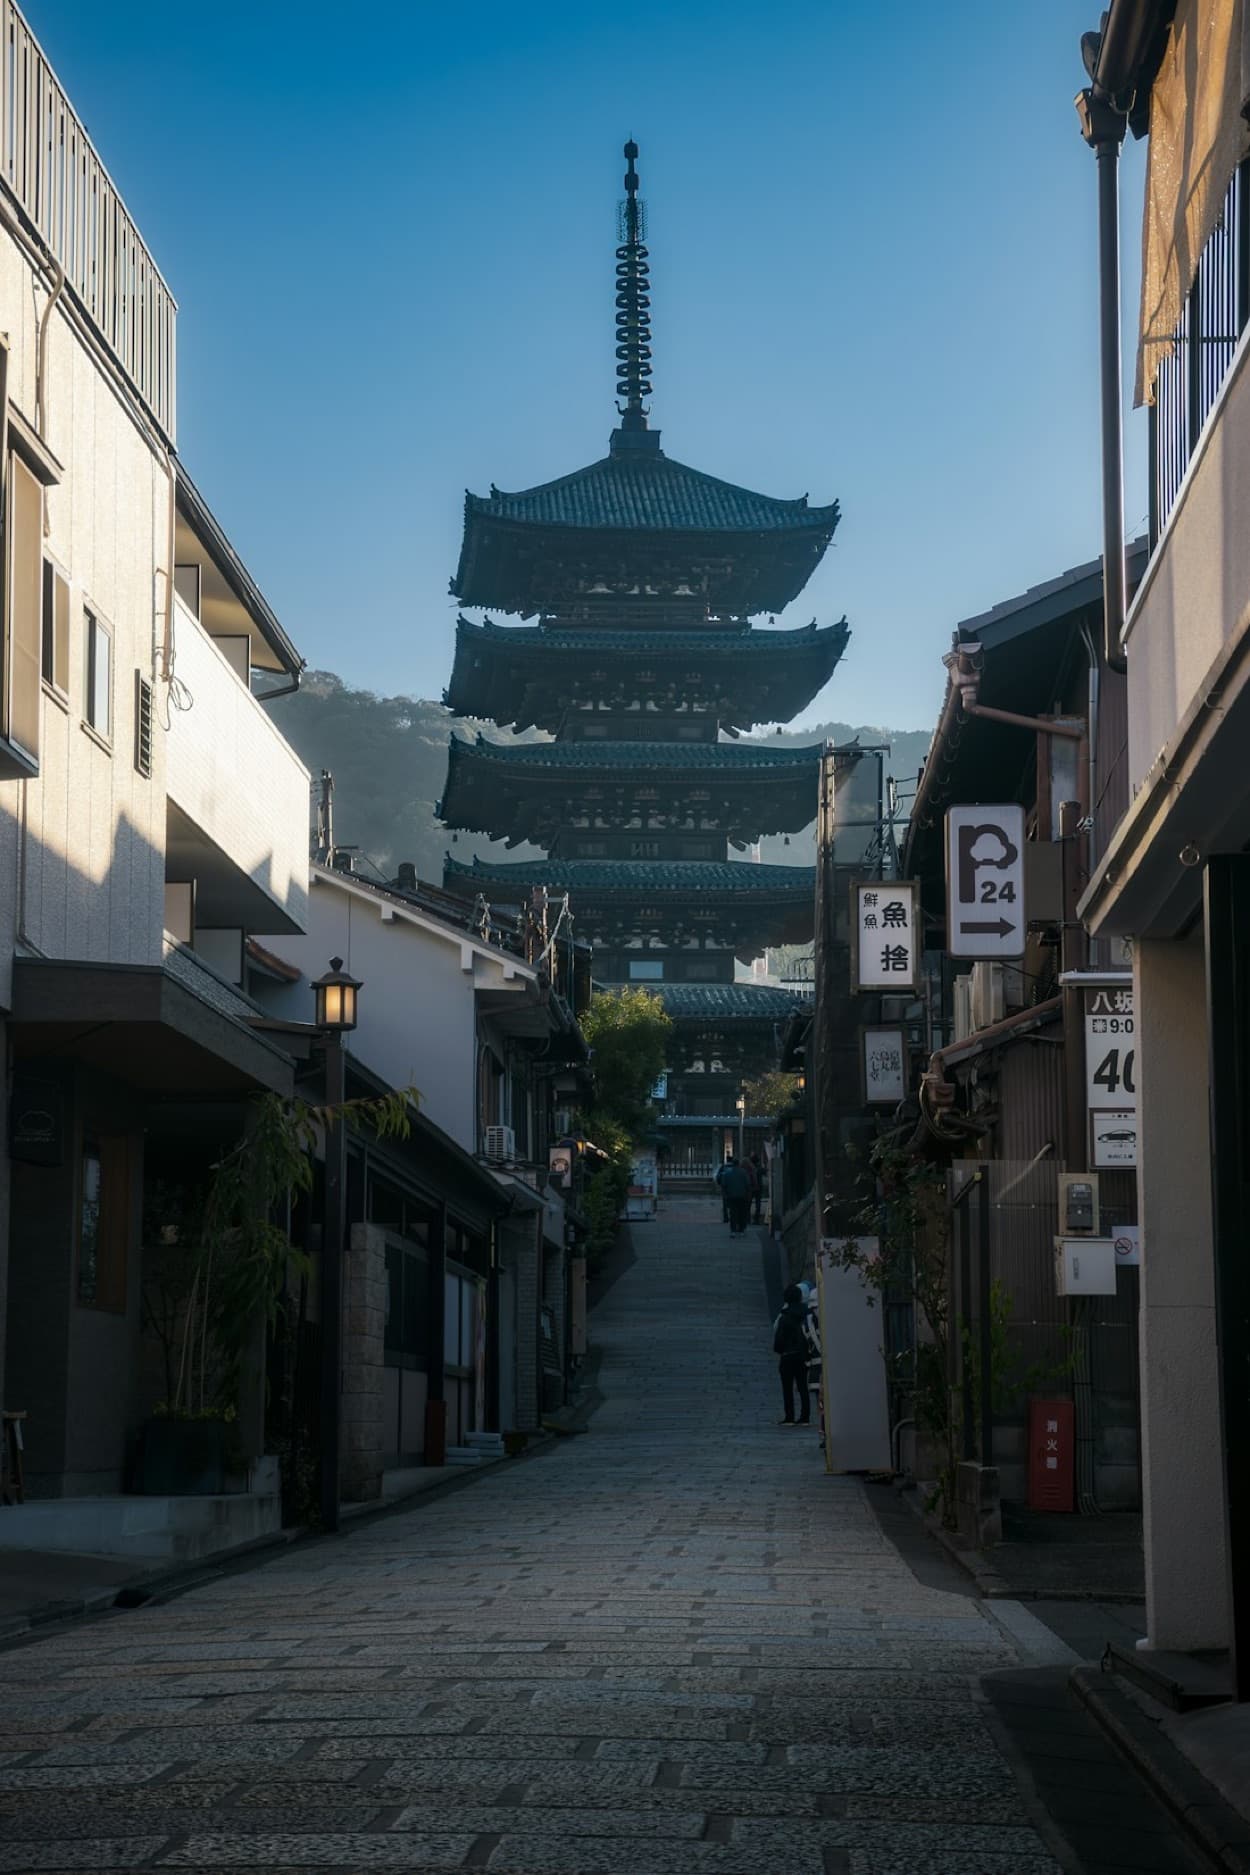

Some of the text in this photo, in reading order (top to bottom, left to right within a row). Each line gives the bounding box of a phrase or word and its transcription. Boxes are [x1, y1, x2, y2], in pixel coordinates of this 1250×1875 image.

[981, 881, 1017, 903] 24
[863, 893, 879, 929] 鮮魚
[880, 902, 909, 972] 魚捨
